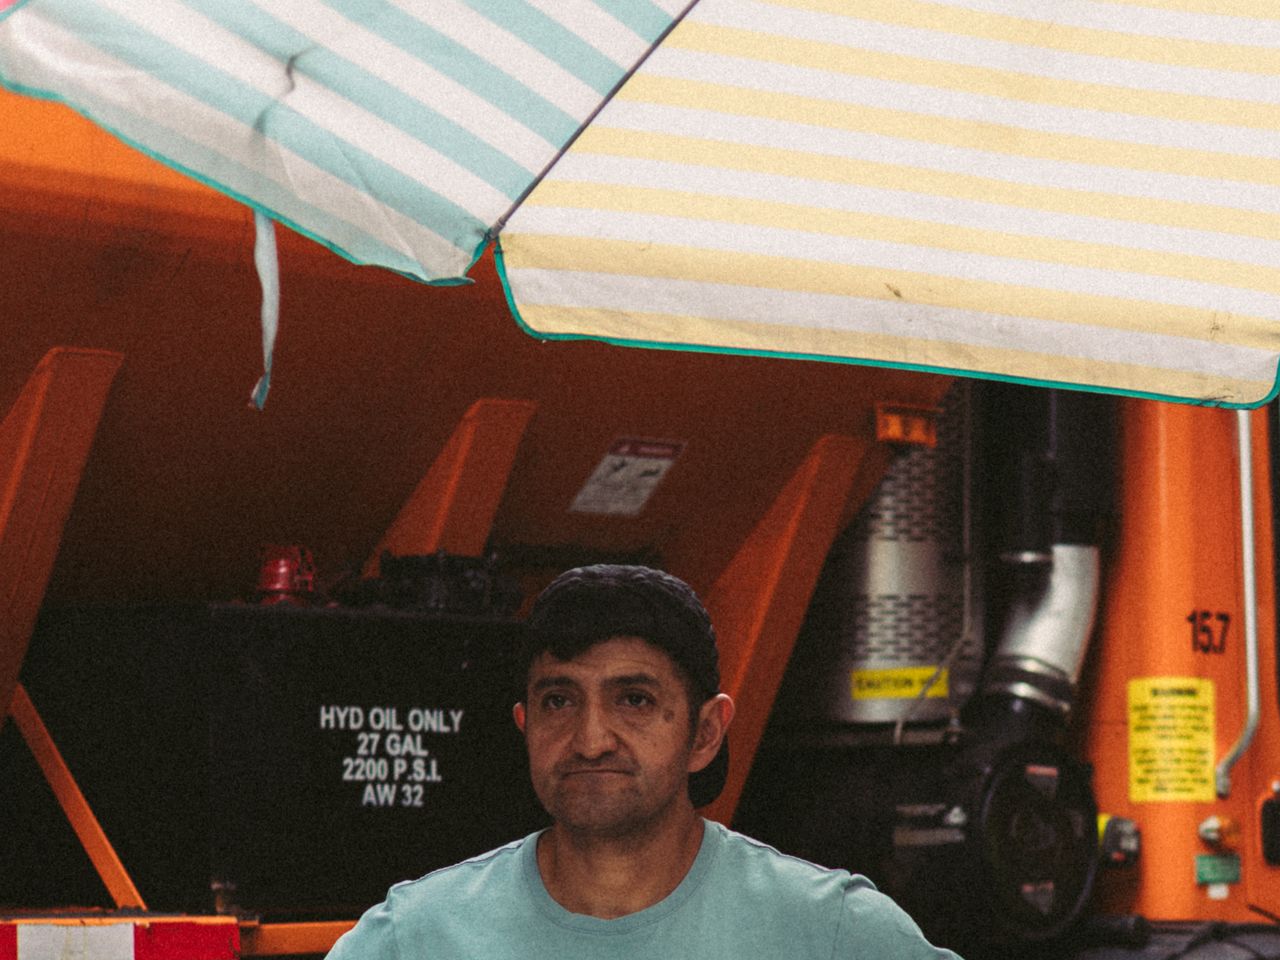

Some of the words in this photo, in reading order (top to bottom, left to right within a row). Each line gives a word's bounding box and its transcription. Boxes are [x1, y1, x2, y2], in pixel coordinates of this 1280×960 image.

[320, 705, 364, 730] HYD
[369, 707, 403, 731] OIL
[408, 709, 463, 733] ONLY
[357, 733, 380, 755] 27
[385, 734, 428, 757] GAL
[343, 758, 388, 781] 2200
[362, 784, 396, 806] AW
[402, 784, 424, 807] 32
